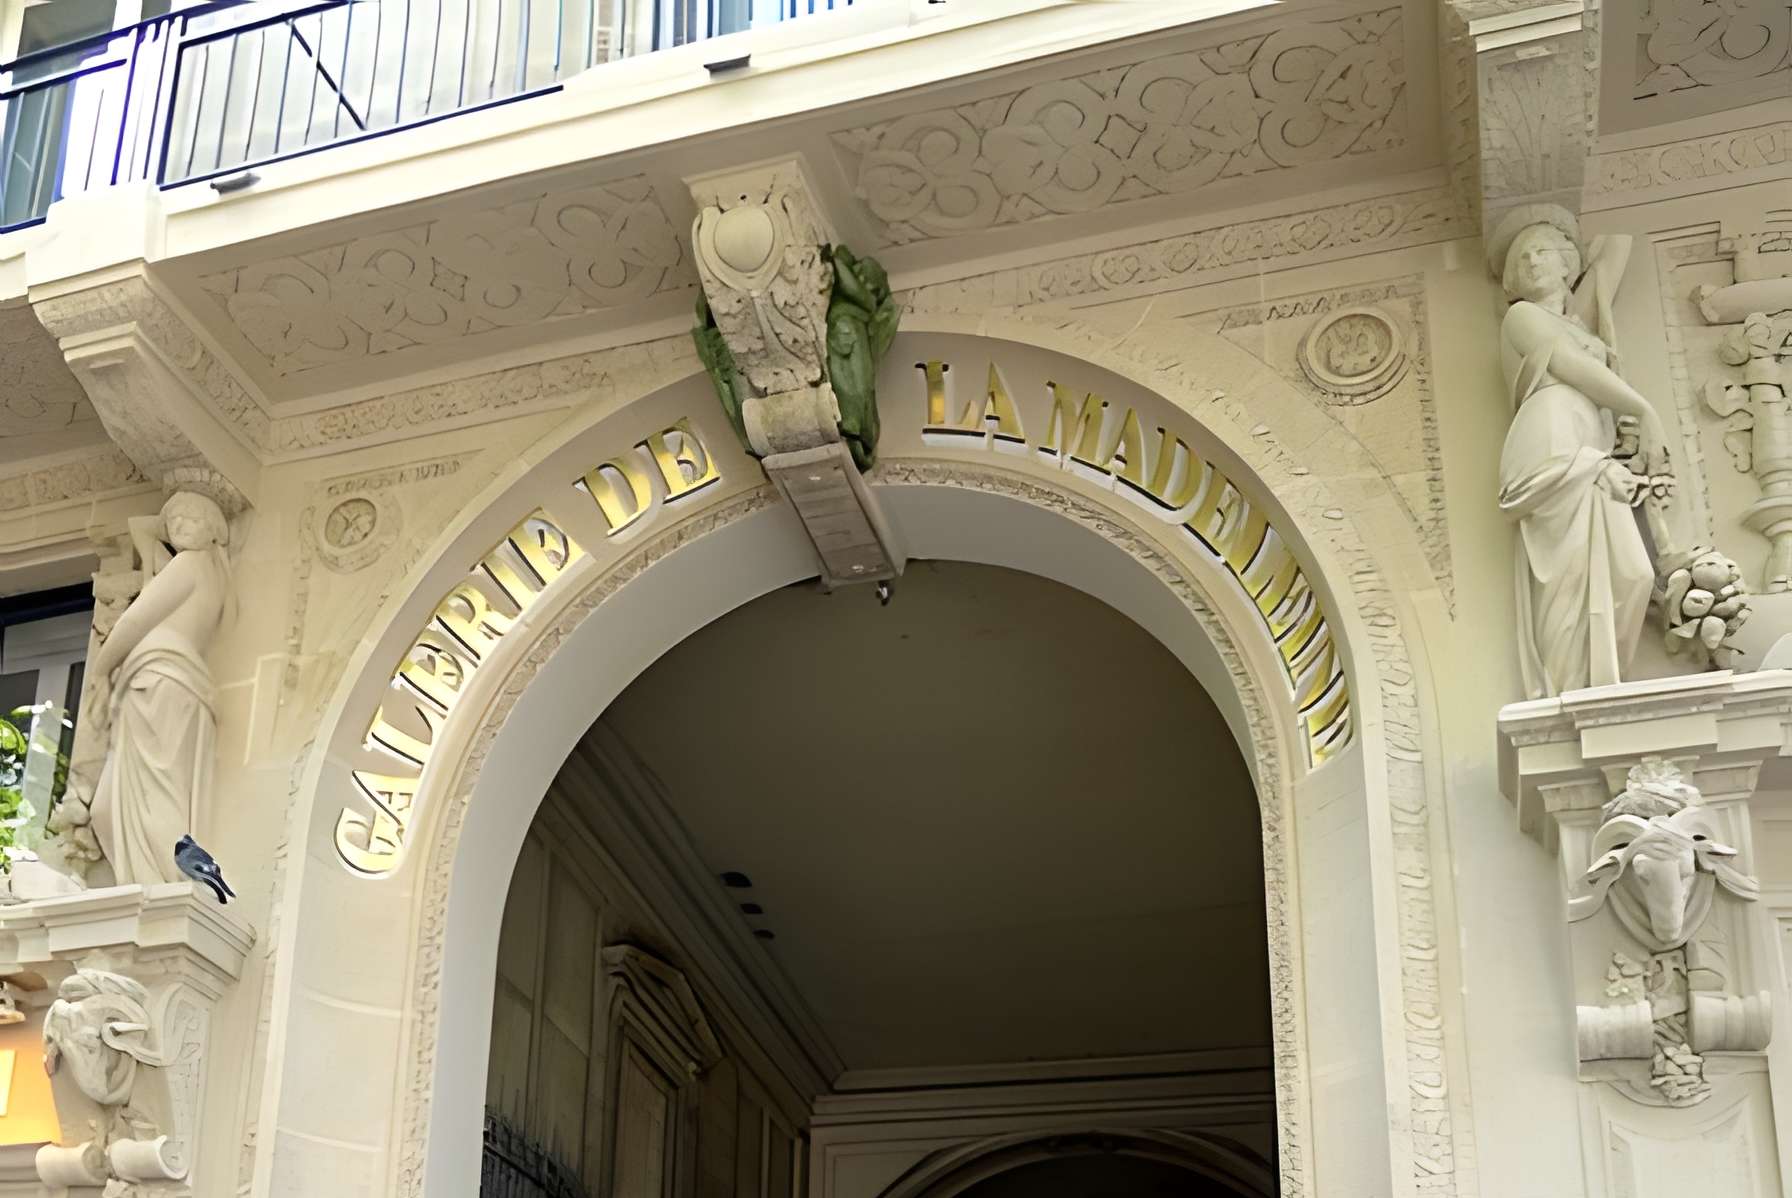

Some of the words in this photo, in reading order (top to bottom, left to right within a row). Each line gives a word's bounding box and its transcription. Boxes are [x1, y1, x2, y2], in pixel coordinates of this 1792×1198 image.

[334, 507, 590, 878] GALERIE
[573, 417, 721, 537] DE
[915, 360, 1026, 446] LA
[1037, 381, 1353, 771] MADELEINE
